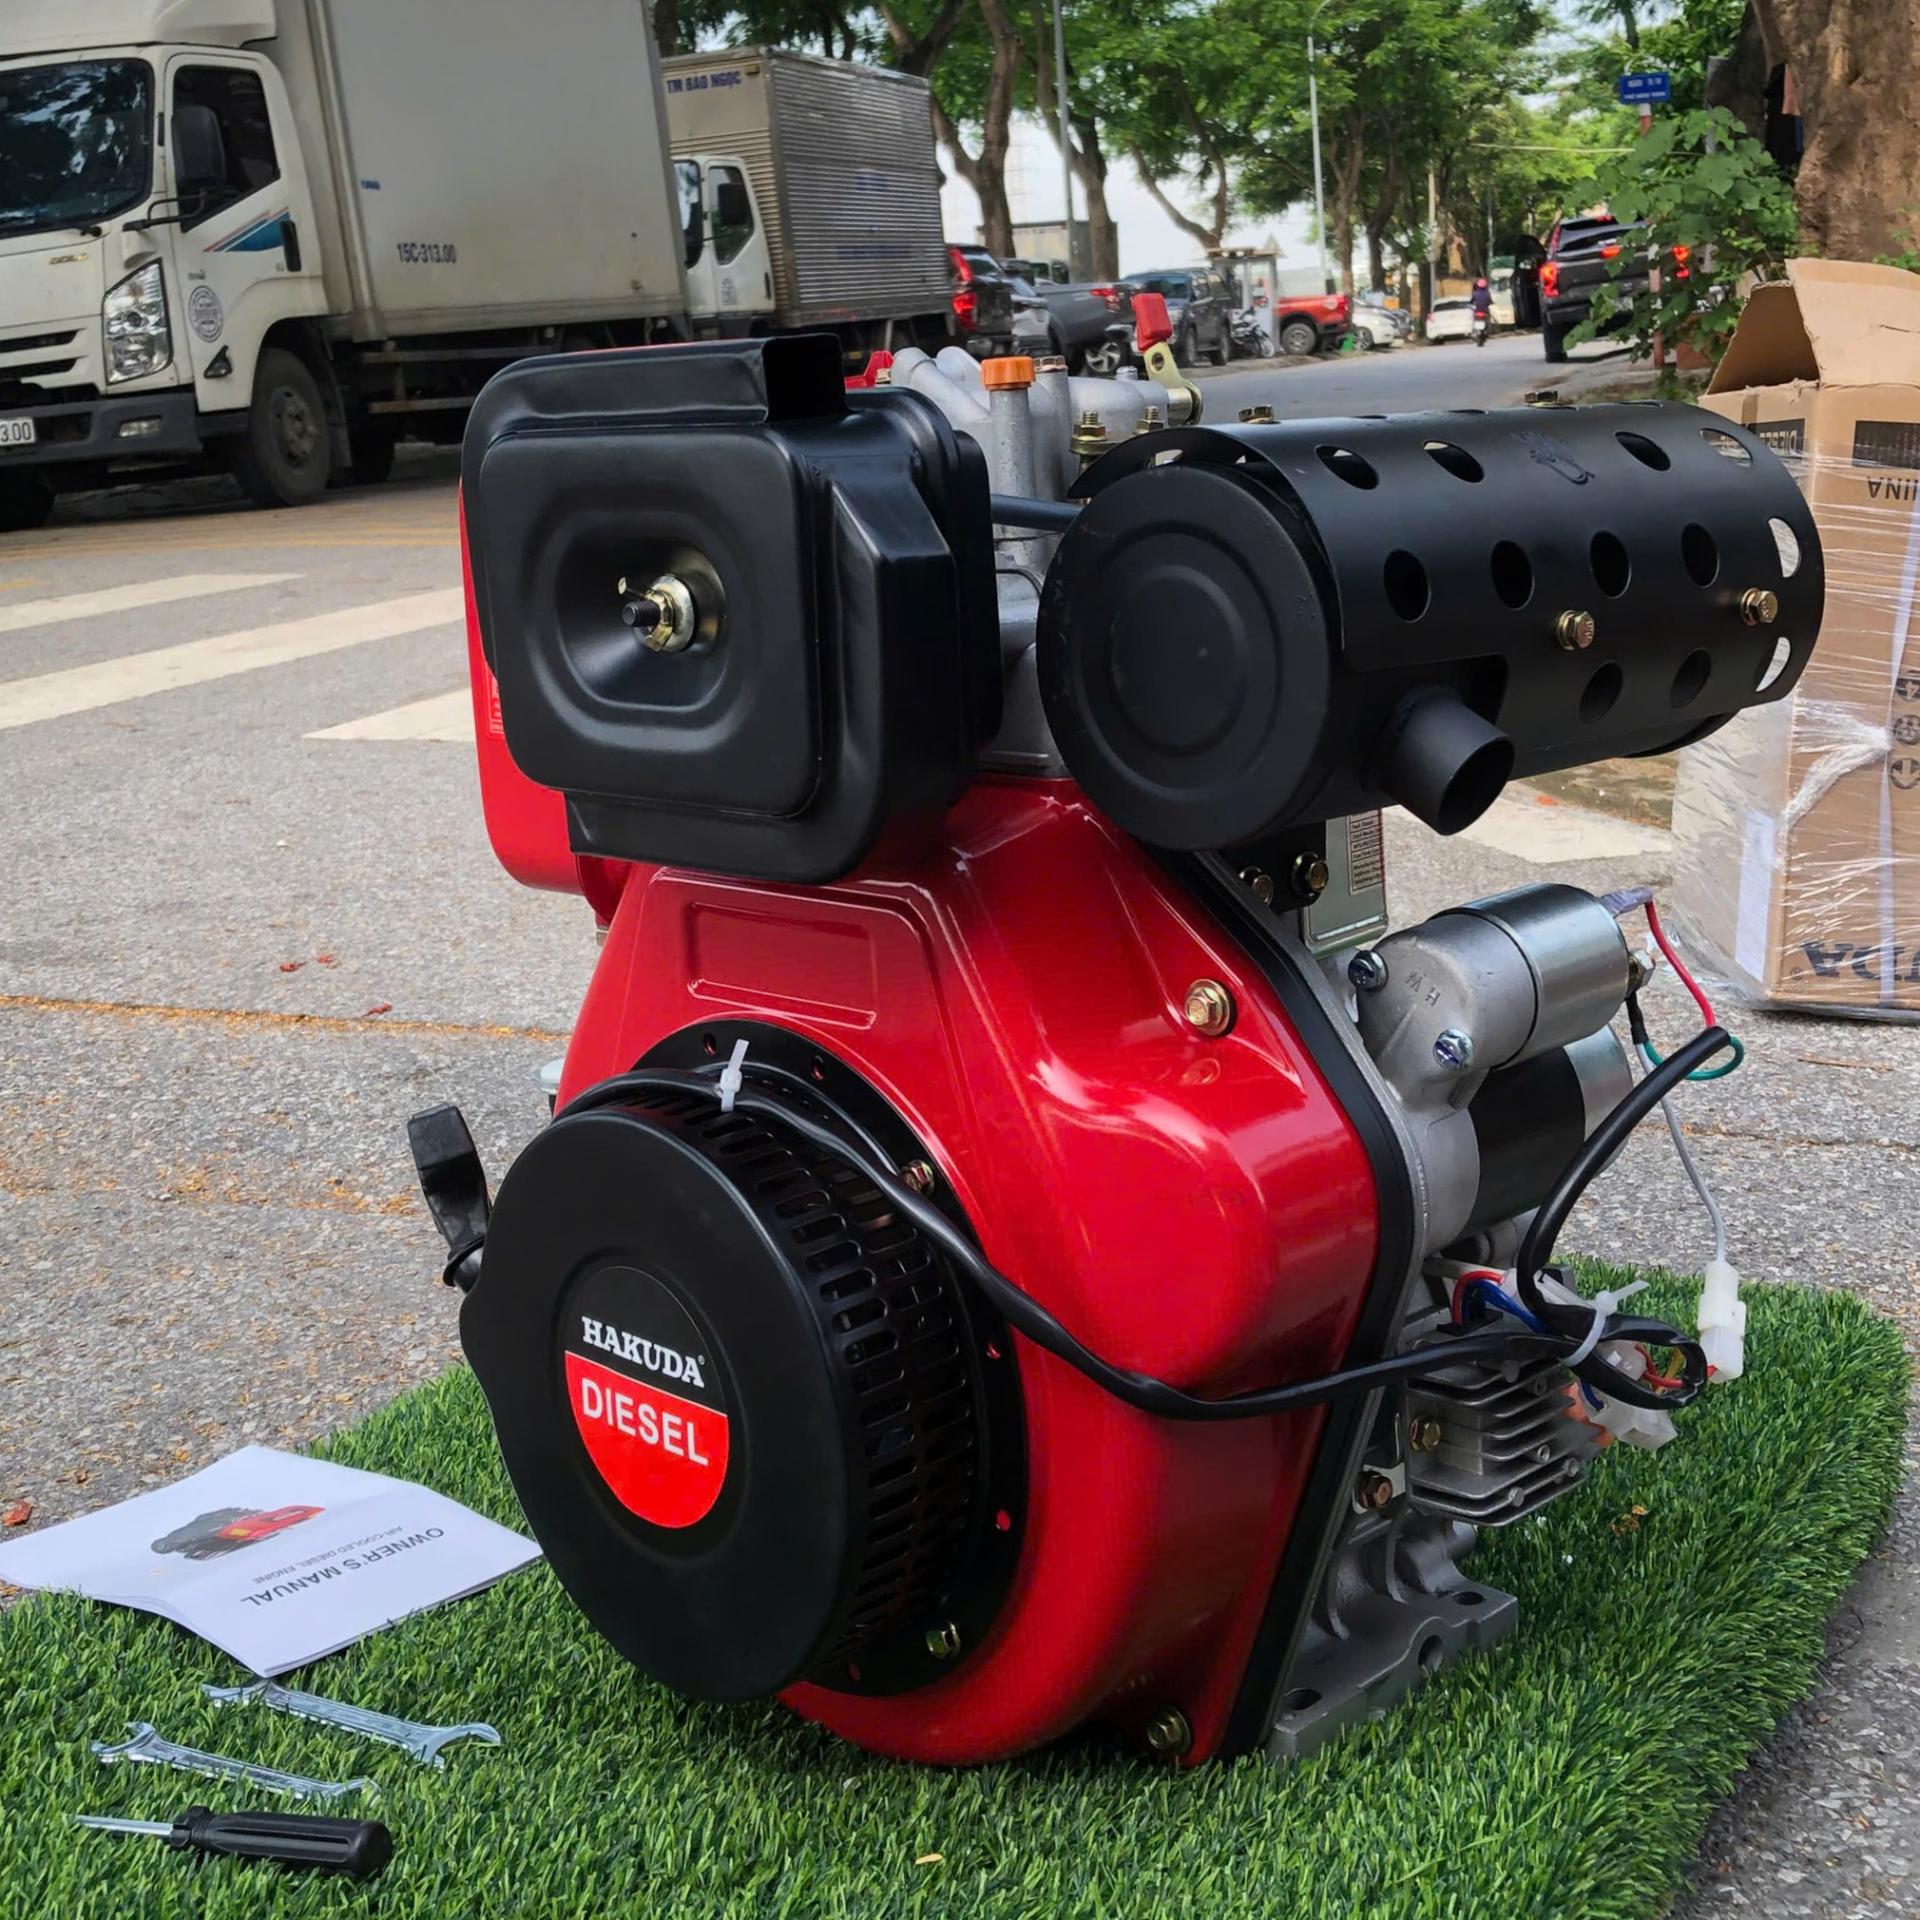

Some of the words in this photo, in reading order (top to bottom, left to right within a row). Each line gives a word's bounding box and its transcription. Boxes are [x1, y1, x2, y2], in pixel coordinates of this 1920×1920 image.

[581, 1377, 709, 1467] DIESEL
[337, 1525, 403, 1553] AIR-COOLED
[343, 1527, 445, 1570] OWNER'S
[251, 1565, 297, 1585] ENGINE
[295, 1550, 338, 1568] DIESEL
[240, 1565, 343, 1606] MANUAL
